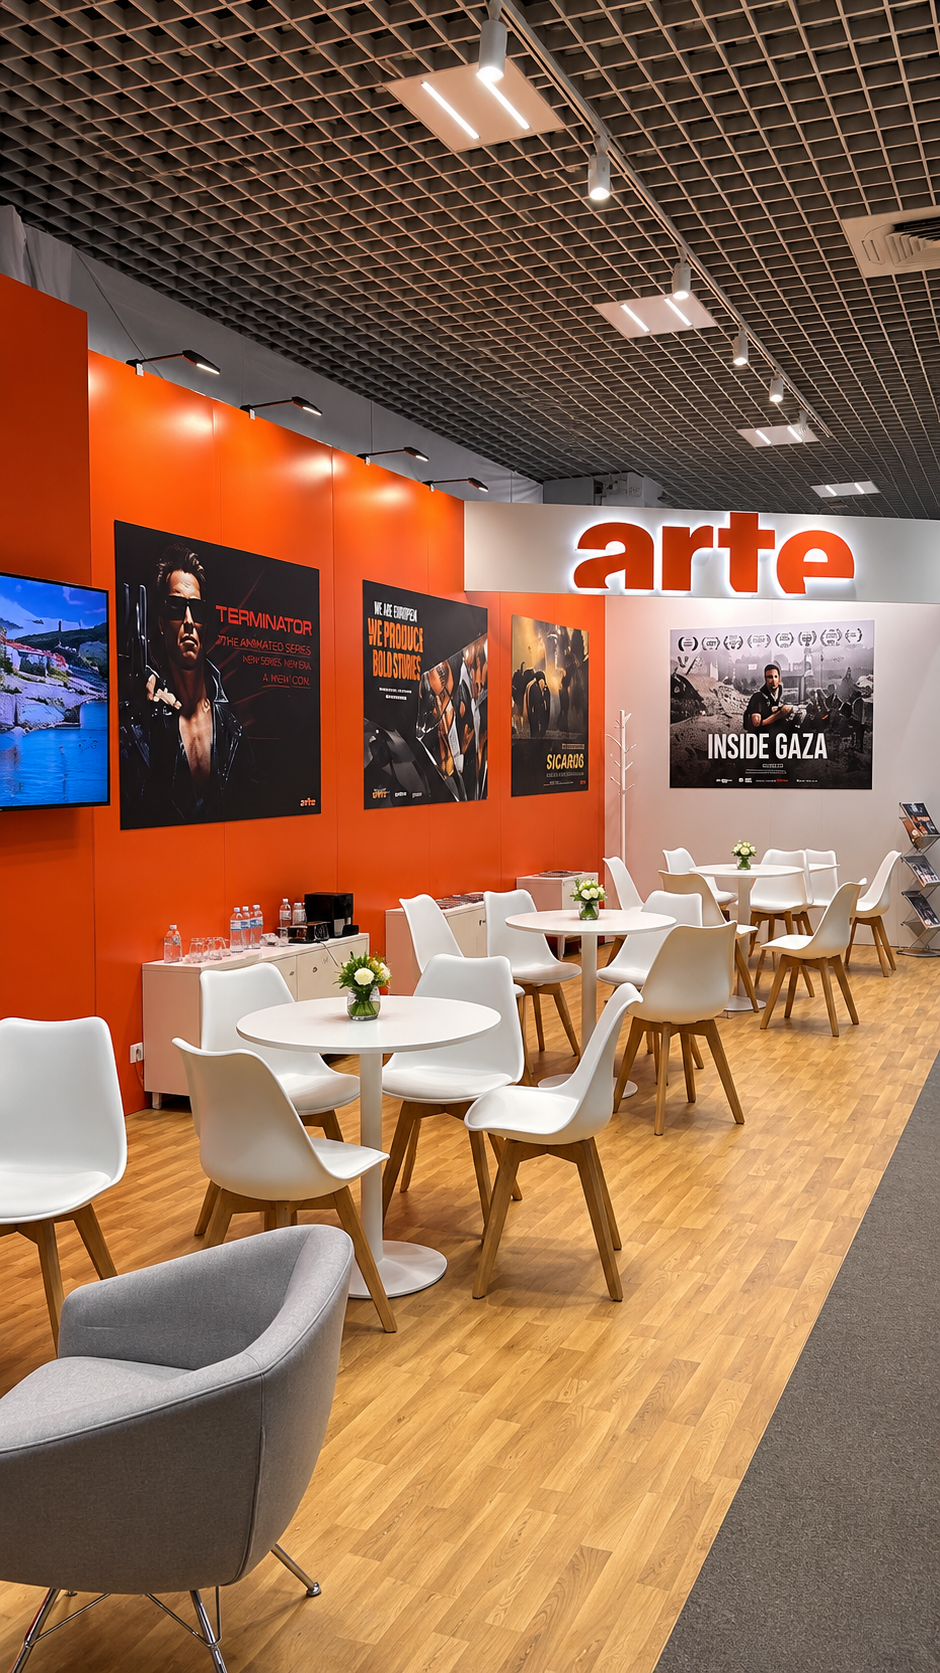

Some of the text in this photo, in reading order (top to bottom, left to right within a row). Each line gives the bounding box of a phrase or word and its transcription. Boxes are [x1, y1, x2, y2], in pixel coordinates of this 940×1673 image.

[573, 512, 855, 594] arte
[216, 605, 312, 636] TERMINATOR
[374, 601, 382, 616] WE
[368, 618, 424, 653] WE PRODUCE
[372, 649, 392, 678] BOLD
[708, 732, 828, 759] INSIDE GAZA
